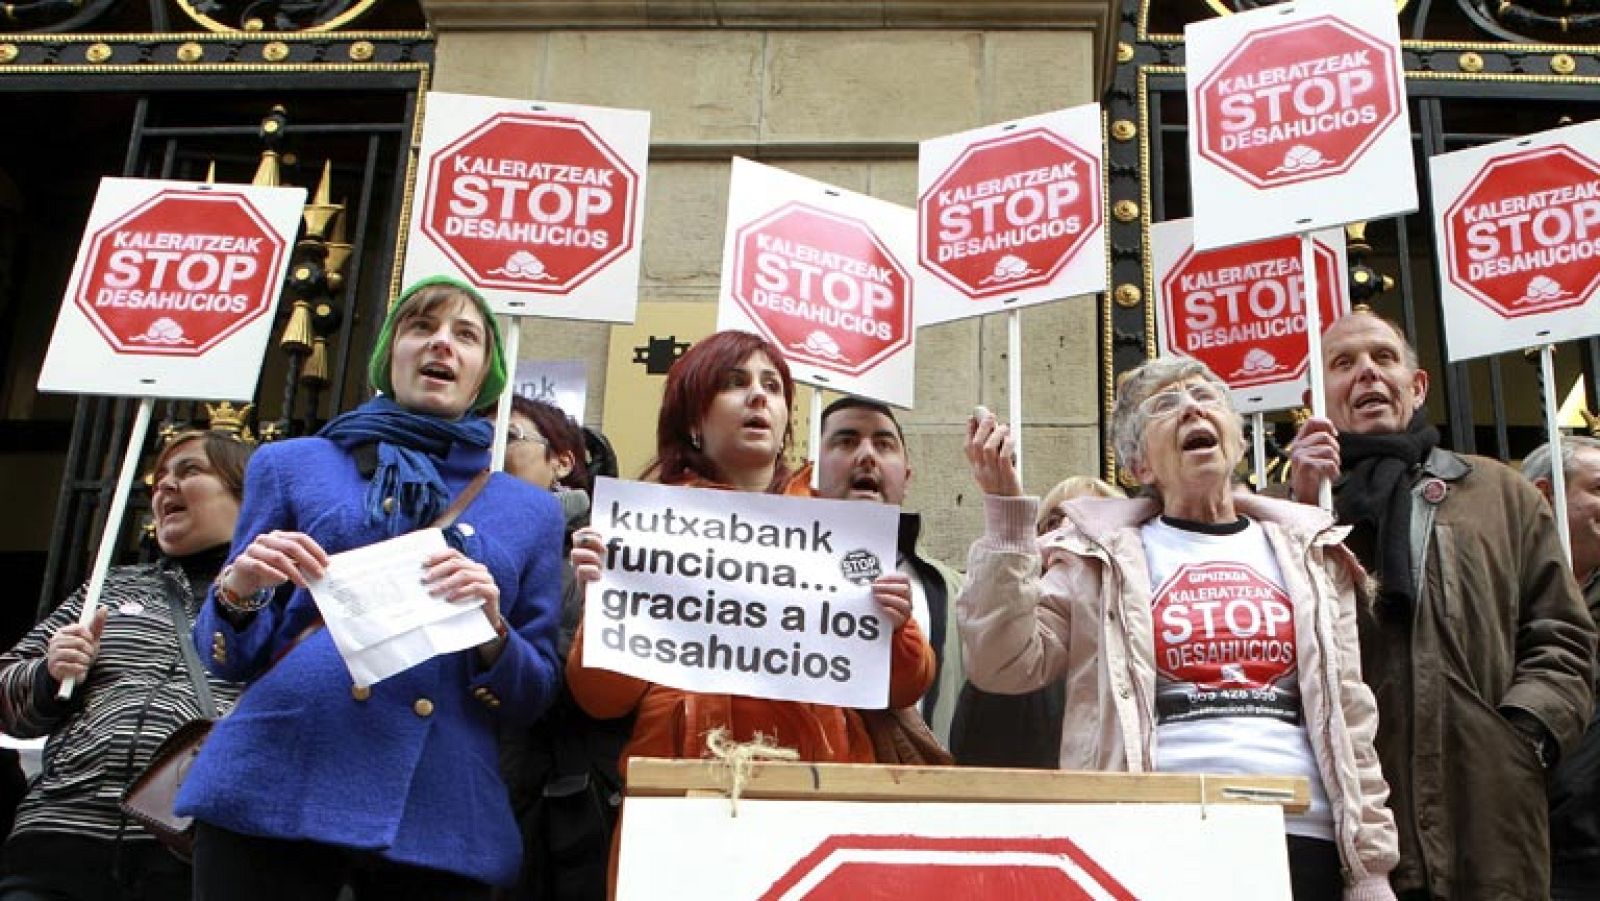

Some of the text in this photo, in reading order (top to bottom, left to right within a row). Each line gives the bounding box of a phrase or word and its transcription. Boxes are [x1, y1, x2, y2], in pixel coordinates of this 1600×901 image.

[1218, 50, 1371, 96] KALERATZEAK
[1219, 69, 1374, 132] STOP
[1220, 105, 1377, 152] DESAHUCIOS
[453, 154, 615, 187] KALERATZEAK
[939, 161, 1077, 206] KALERATZEAK
[449, 174, 613, 226] STOP
[938, 179, 1080, 241] STOP
[112, 230, 264, 254] KALERATZEAK
[445, 216, 609, 250] DESAHUCIOS
[938, 216, 1080, 263] DESAHUCIOS
[1466, 200, 1600, 260] STOP
[103, 249, 259, 293] STOP
[756, 232, 893, 286] KALERATZEAK
[1181, 256, 1304, 293] KALERATZEA
[95, 287, 249, 314] DESAHUCIOS
[754, 252, 894, 317] STOP
[752, 288, 893, 341] DESAHUCIOS
[1186, 314, 1322, 351] DESAHUCIO
[610, 500, 834, 554] kutxabank
[605, 537, 838, 593] funciona...
[601, 587, 881, 641] gracias a los
[1168, 586, 1276, 603] KALERATZEAK
[1161, 598, 1291, 644] STOP
[601, 623, 852, 683] desahucios
[1166, 640, 1293, 671] DESAHUCIOS
